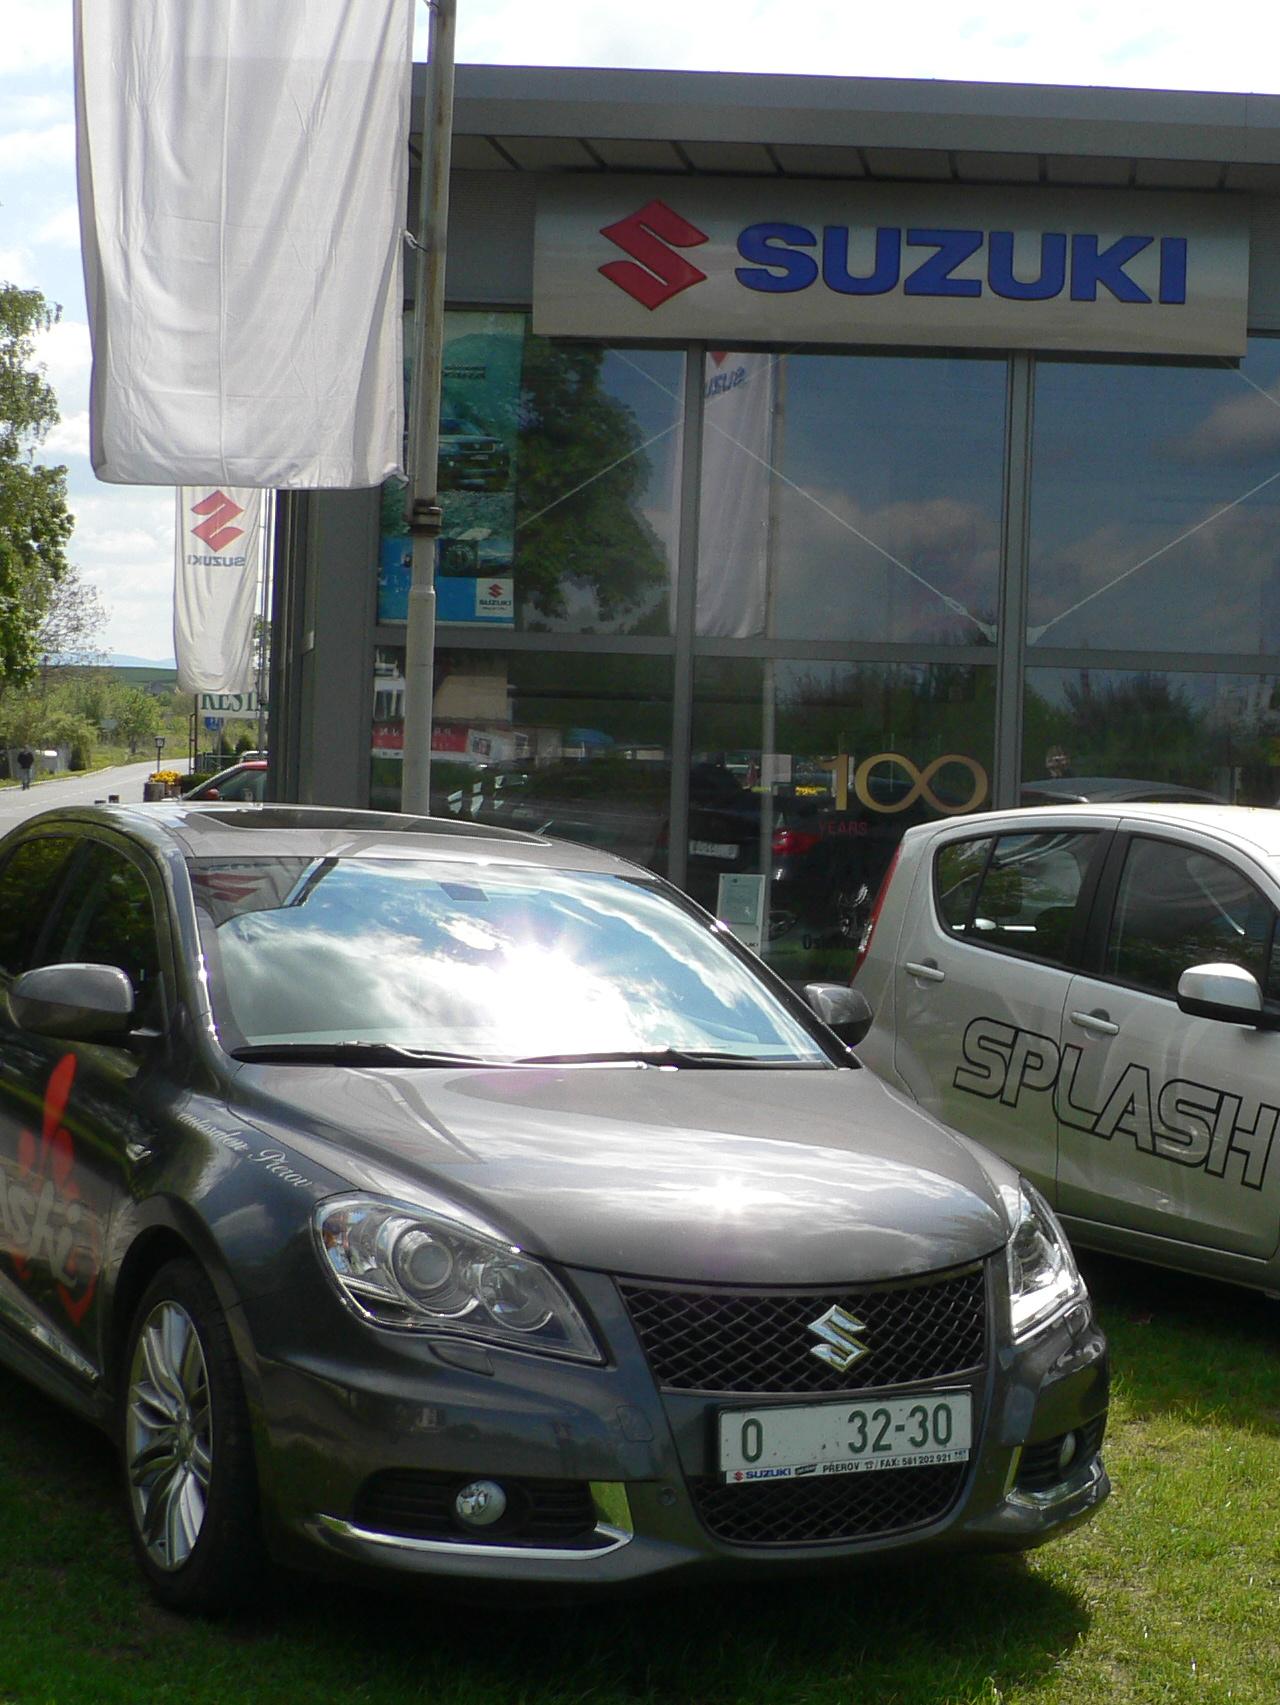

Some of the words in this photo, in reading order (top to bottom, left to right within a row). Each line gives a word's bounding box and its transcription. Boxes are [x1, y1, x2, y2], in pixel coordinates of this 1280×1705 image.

[735, 222, 1187, 304] SUZUKI
[848, 1403, 952, 1453] 32-30
[745, 1468, 792, 1480] SUZUKI
[880, 1457, 900, 1469] FAX:
